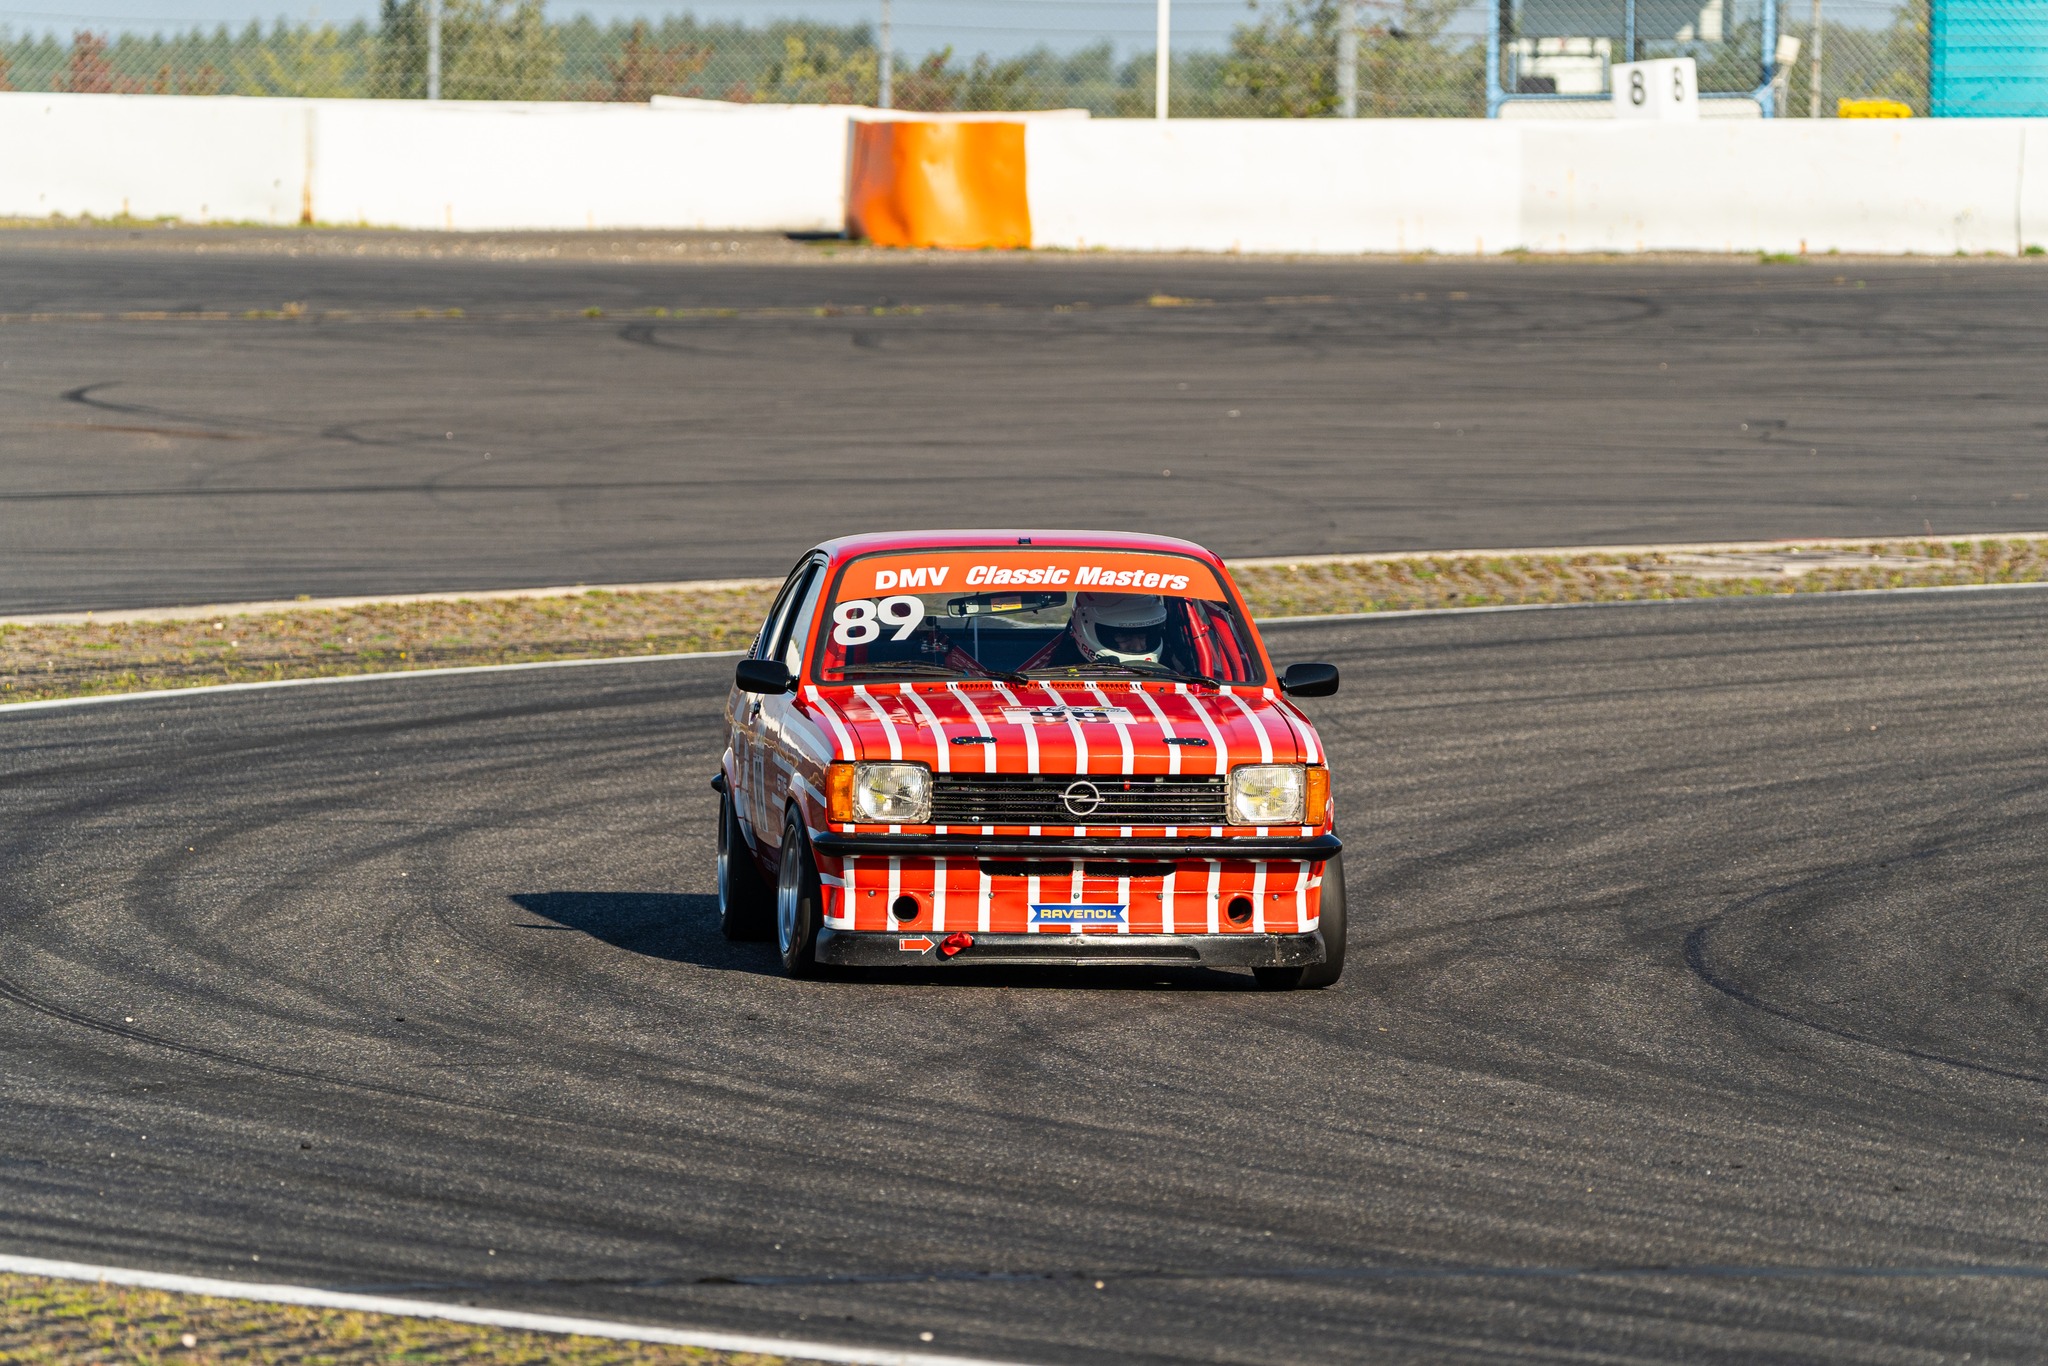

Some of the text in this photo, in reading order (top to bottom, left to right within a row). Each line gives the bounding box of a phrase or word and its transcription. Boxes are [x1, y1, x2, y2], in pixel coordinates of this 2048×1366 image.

[1630, 68, 1645, 106] 8
[874, 565, 1190, 591] DMV Classic Masters
[833, 595, 925, 646] 89
[1040, 909, 1117, 919] RAVENOL
